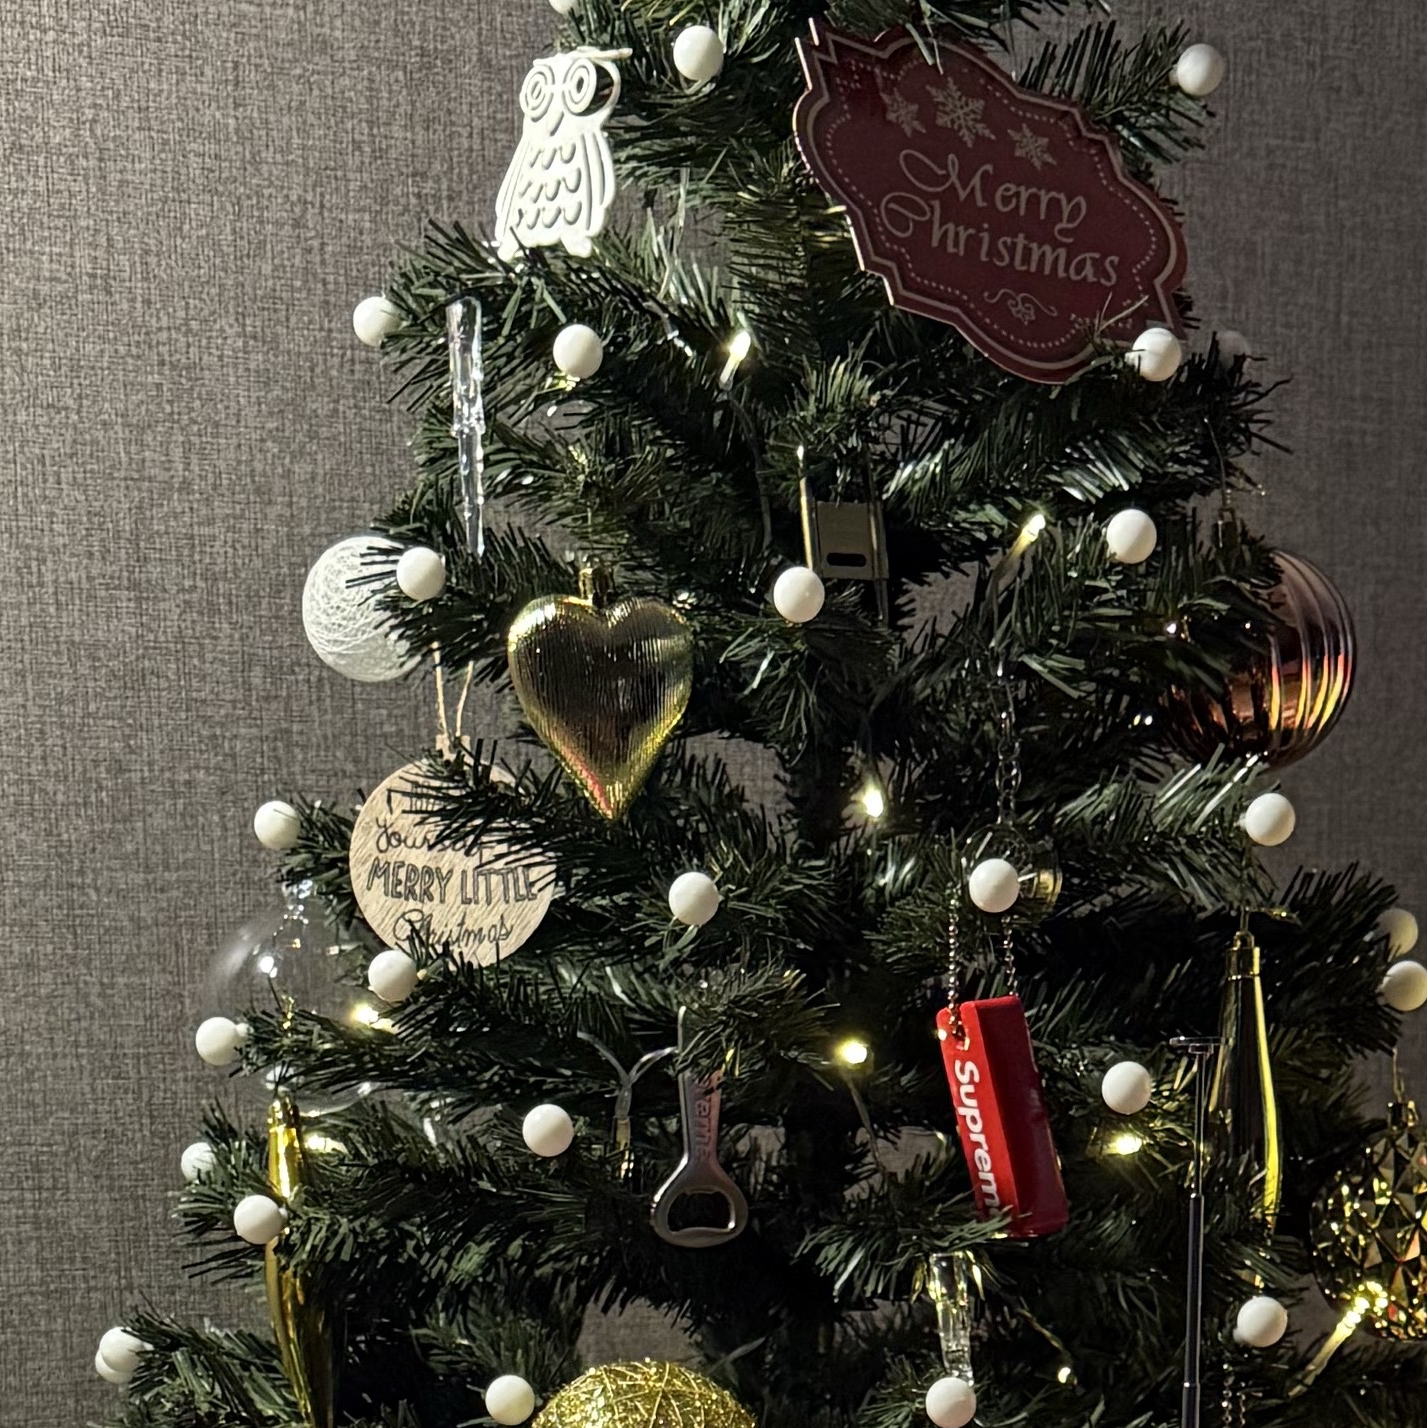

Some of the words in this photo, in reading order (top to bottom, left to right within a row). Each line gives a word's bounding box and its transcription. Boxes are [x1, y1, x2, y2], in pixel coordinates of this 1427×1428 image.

[899, 149, 1086, 242] Merry
[881, 192, 1119, 286] Christmas
[366, 857, 453, 904] MERRY
[461, 867, 538, 906] LITTLE
[393, 909, 513, 947] Christmas
